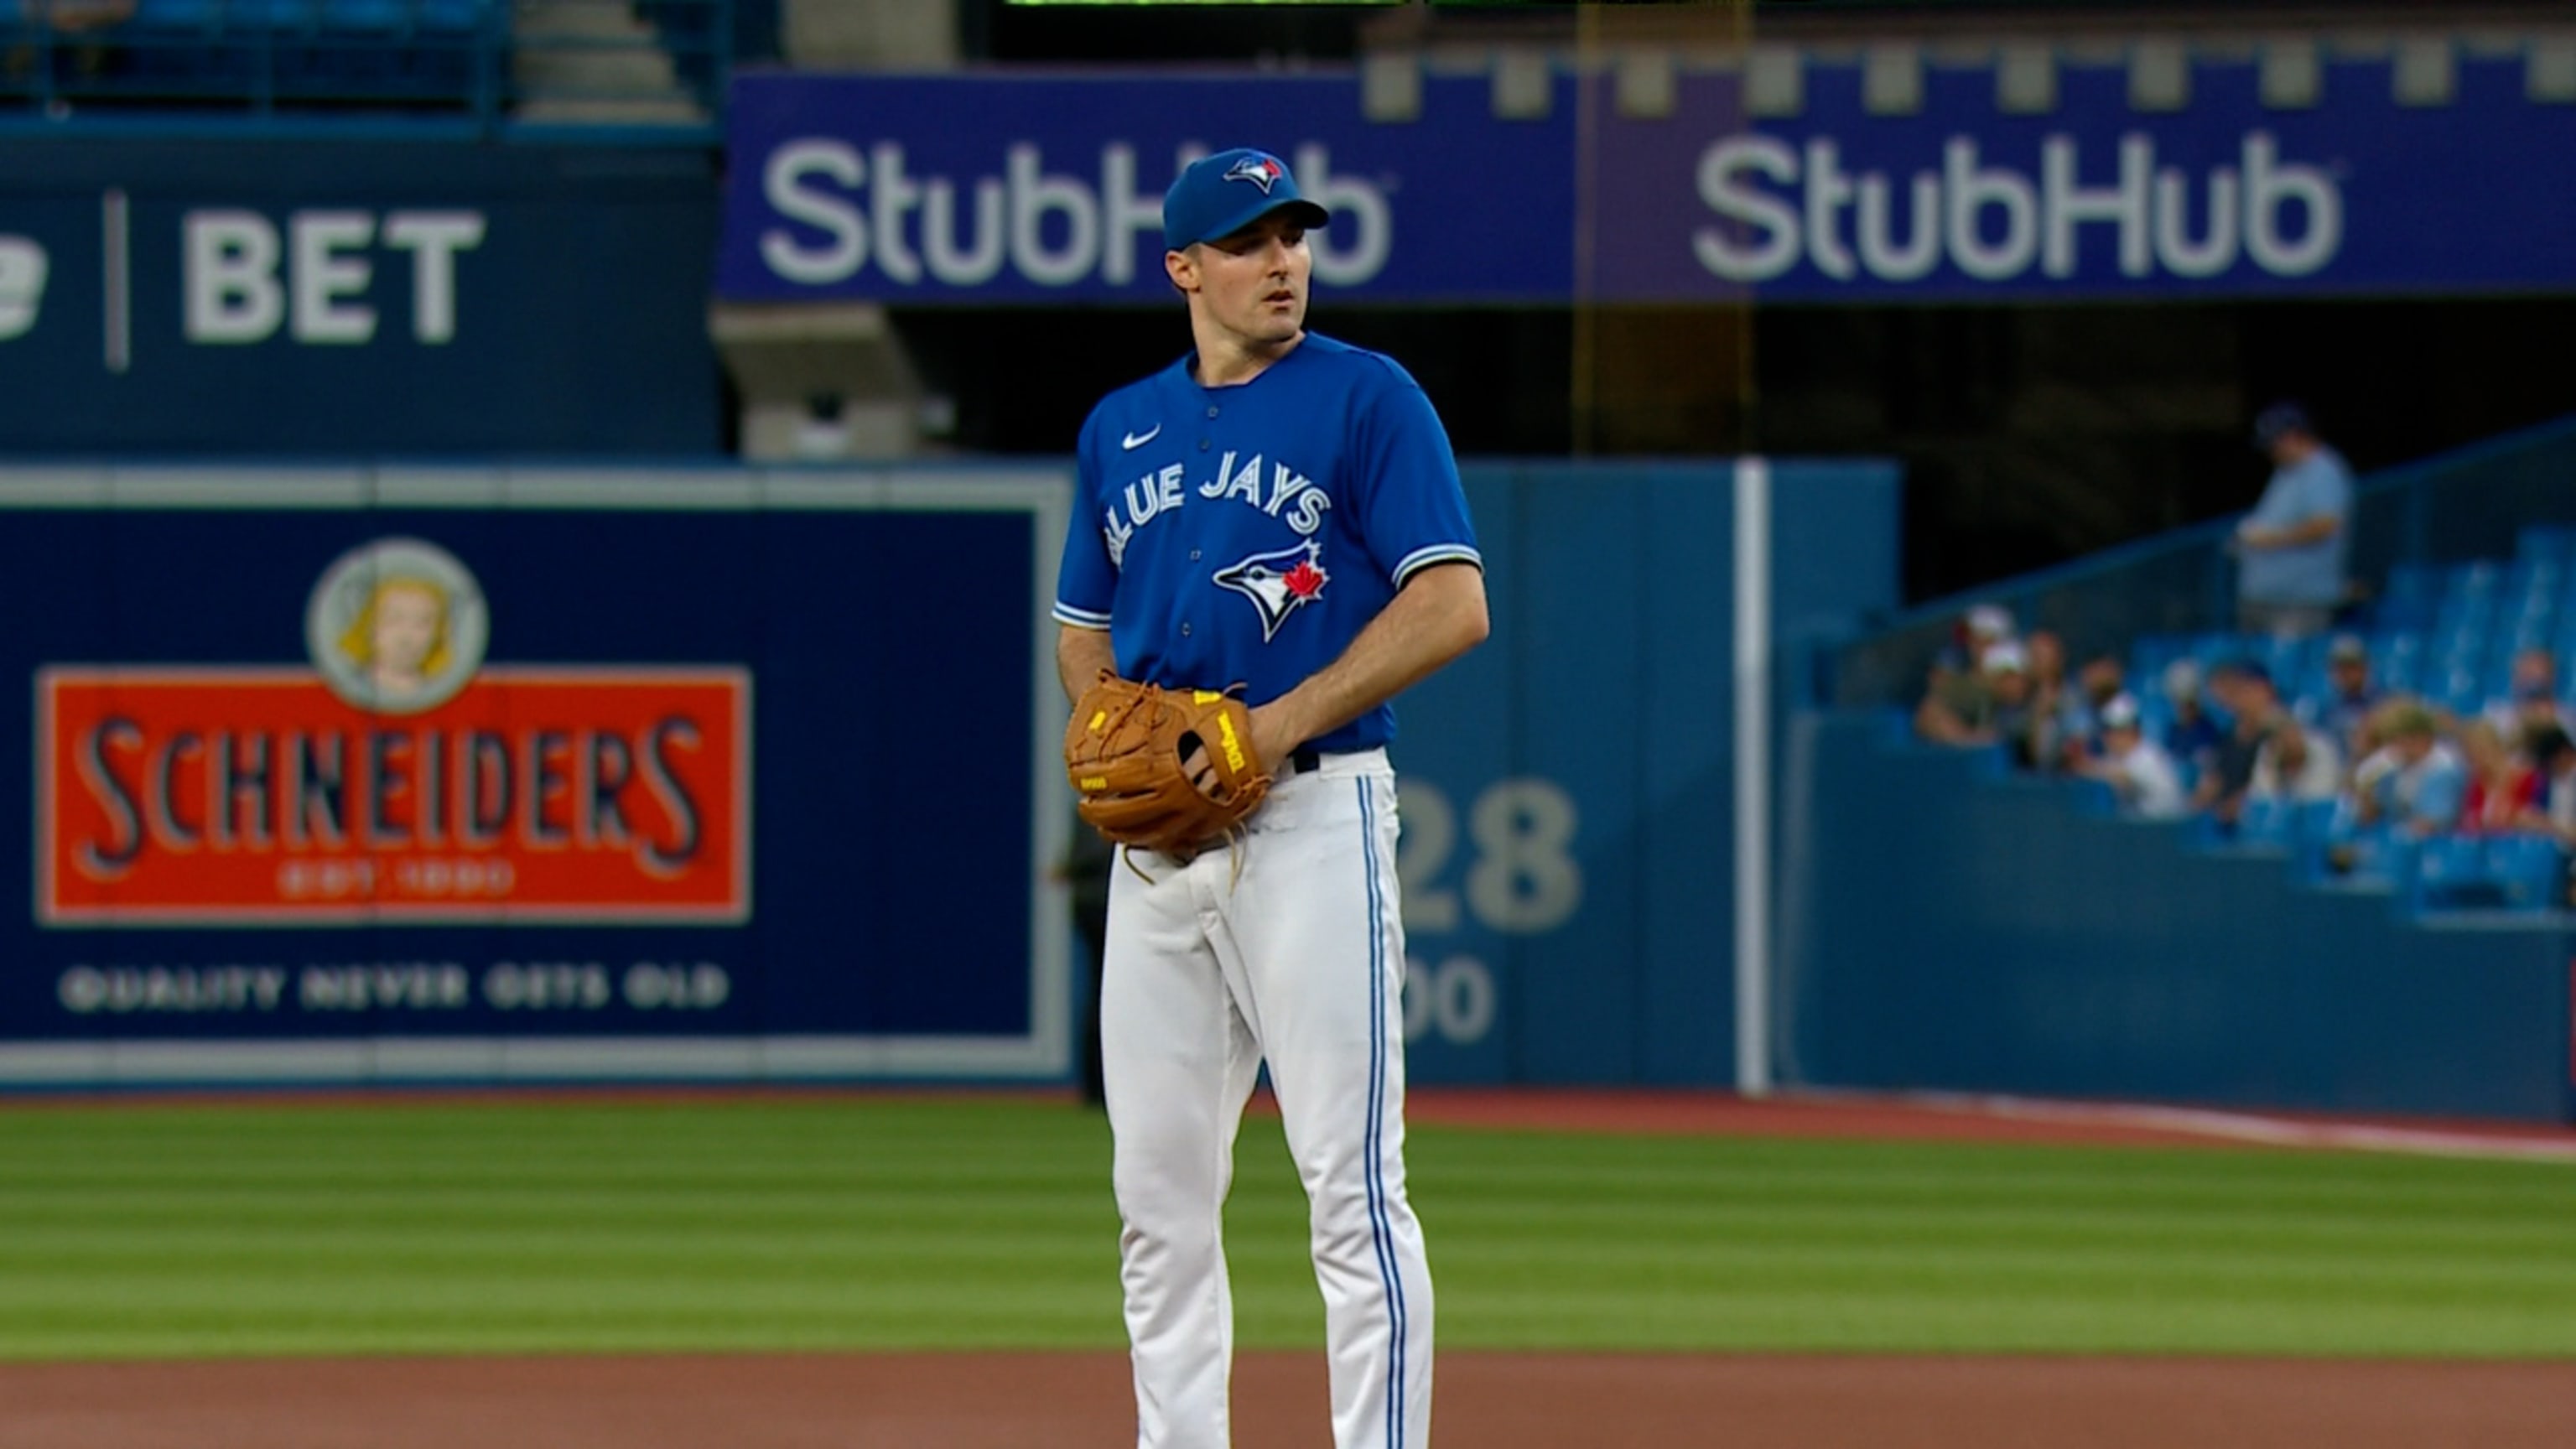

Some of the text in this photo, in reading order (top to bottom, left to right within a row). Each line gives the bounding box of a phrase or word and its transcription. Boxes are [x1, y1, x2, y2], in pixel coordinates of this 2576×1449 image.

[182, 209, 486, 344] BET
[761, 138, 1392, 287] StubHb
[1691, 131, 2343, 283] StubHub
[1198, 450, 1332, 535] JAYS
[71, 715, 704, 883] SCHNEIDERS
[57, 963, 730, 1013] QUALITY NEVER GETS OLD
